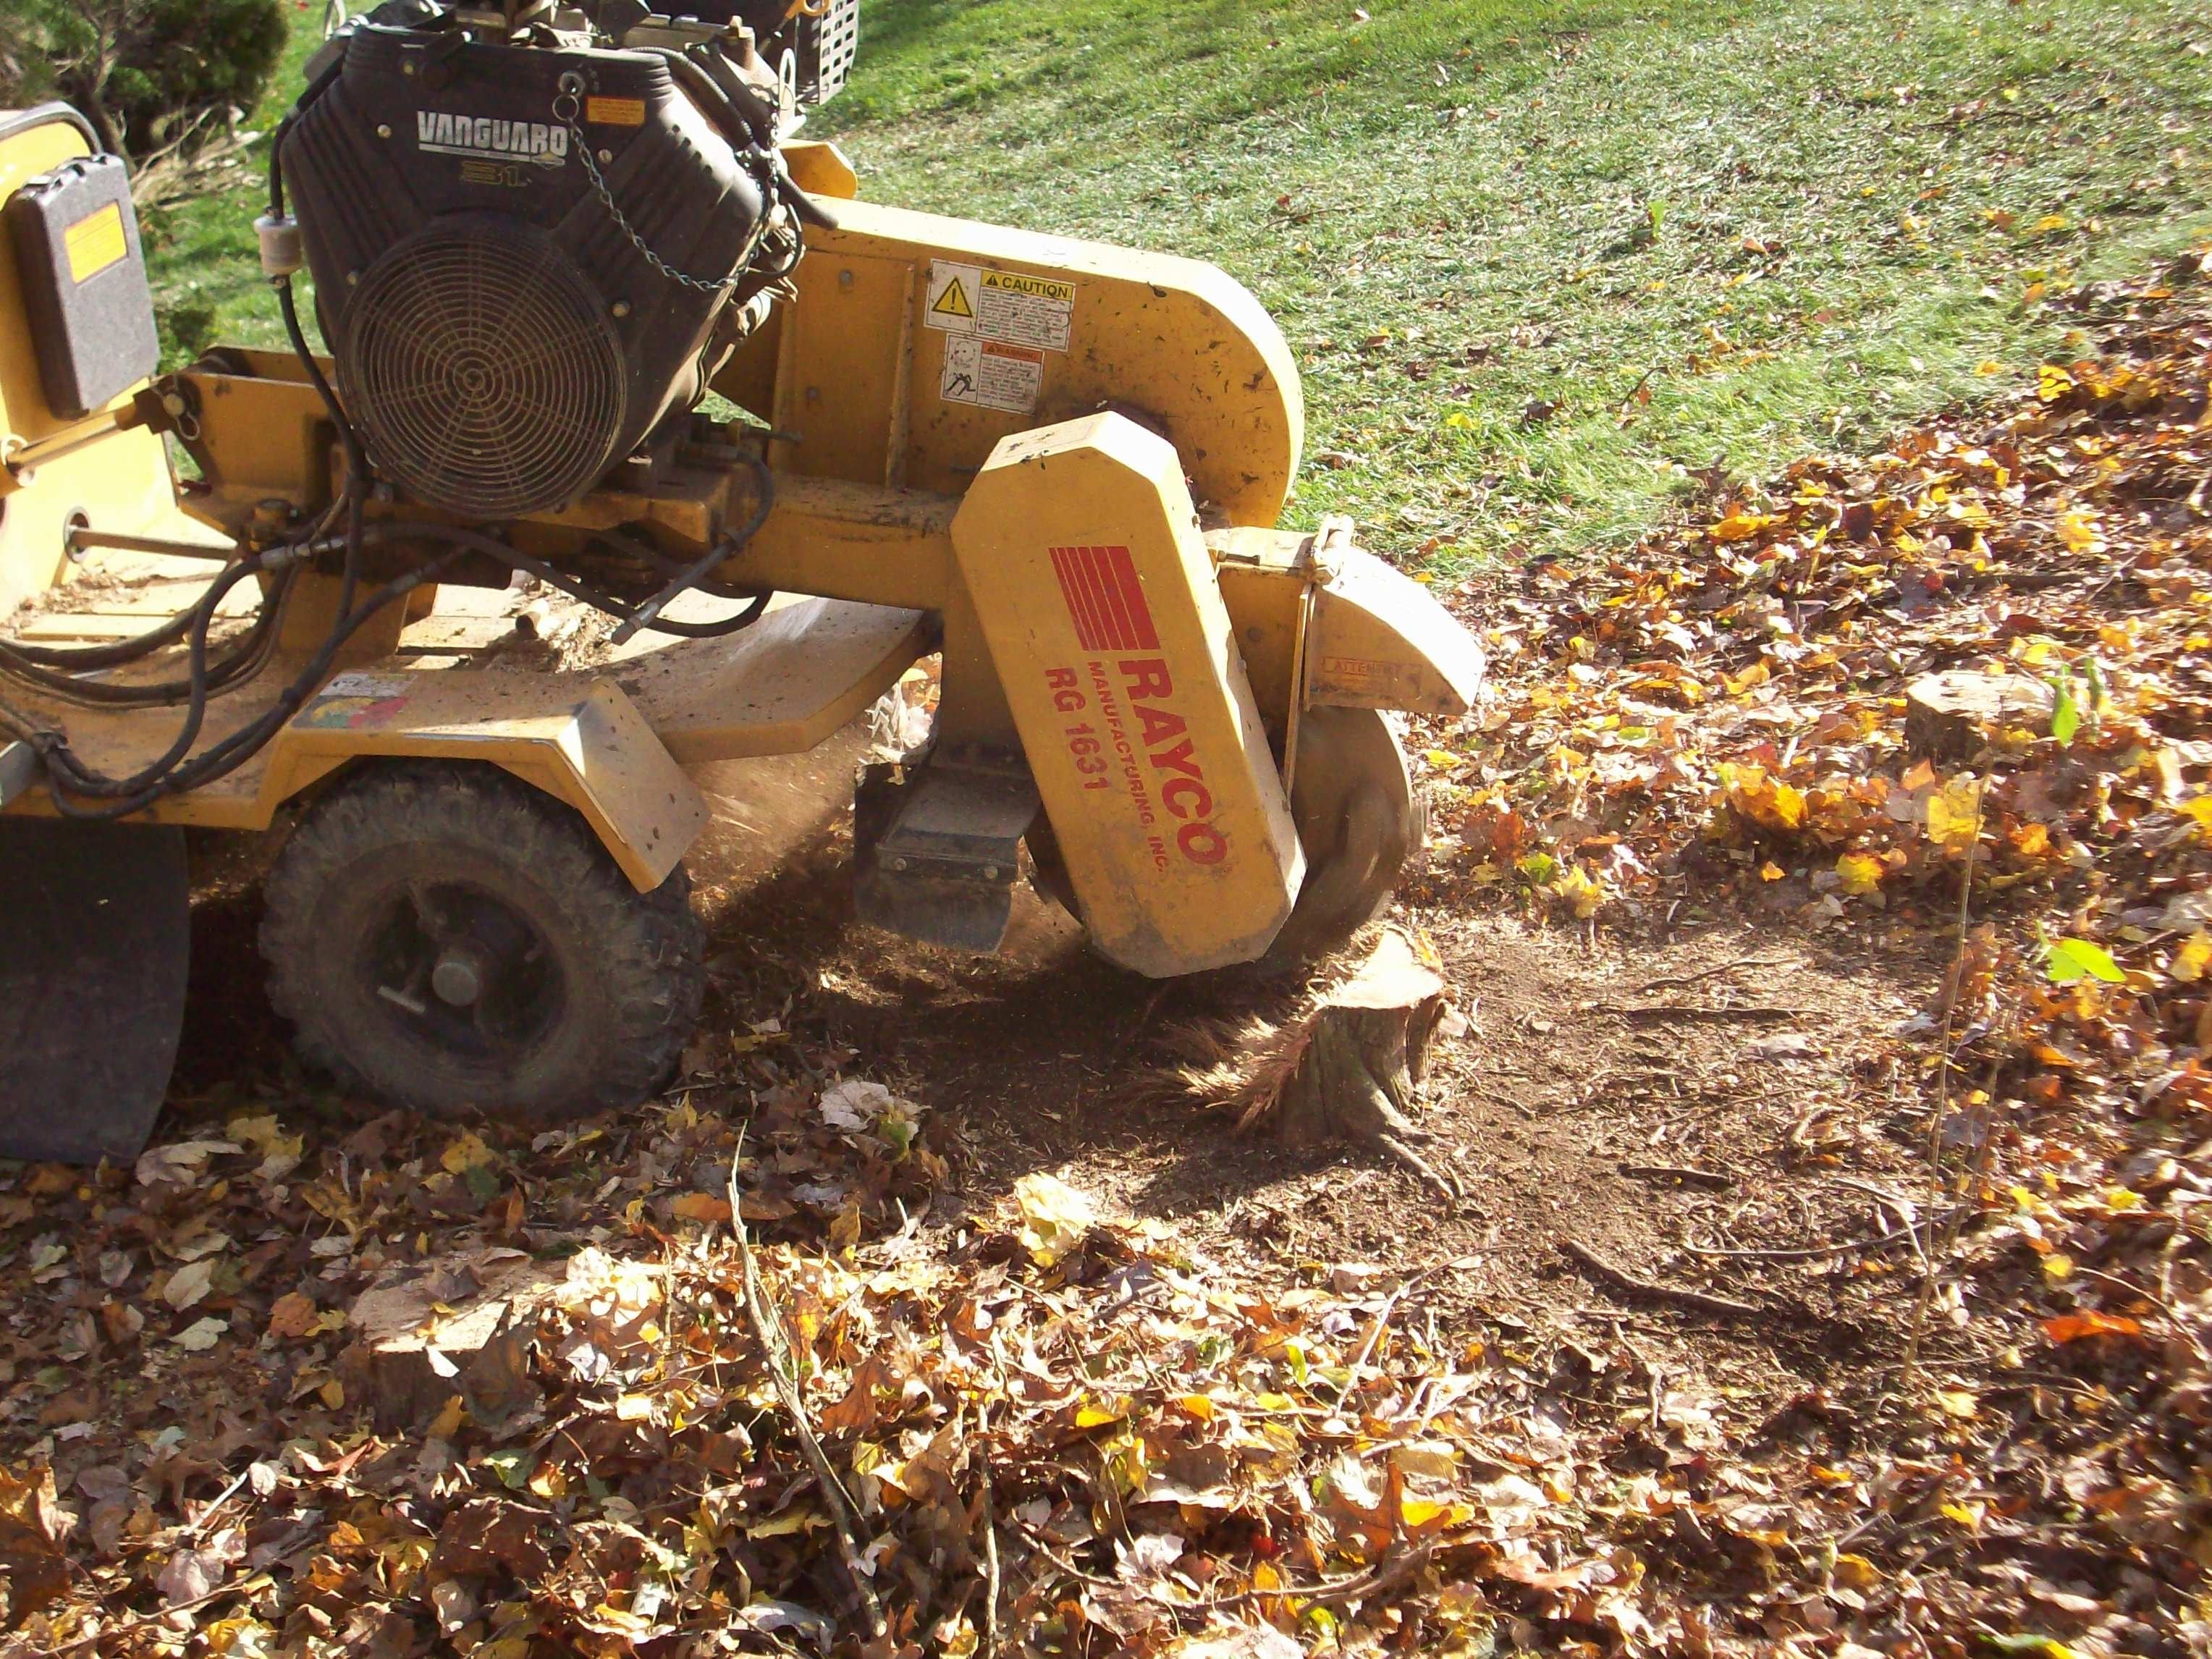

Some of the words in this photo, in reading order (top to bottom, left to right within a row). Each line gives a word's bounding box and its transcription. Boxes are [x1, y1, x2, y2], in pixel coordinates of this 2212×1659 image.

[417, 110, 568, 156] VANGUARD
[1002, 276, 1068, 298] CAUTION
[1044, 667, 1086, 712] RG
[1065, 723, 1109, 790] 1631
[1118, 658, 1228, 866] RAYCO
